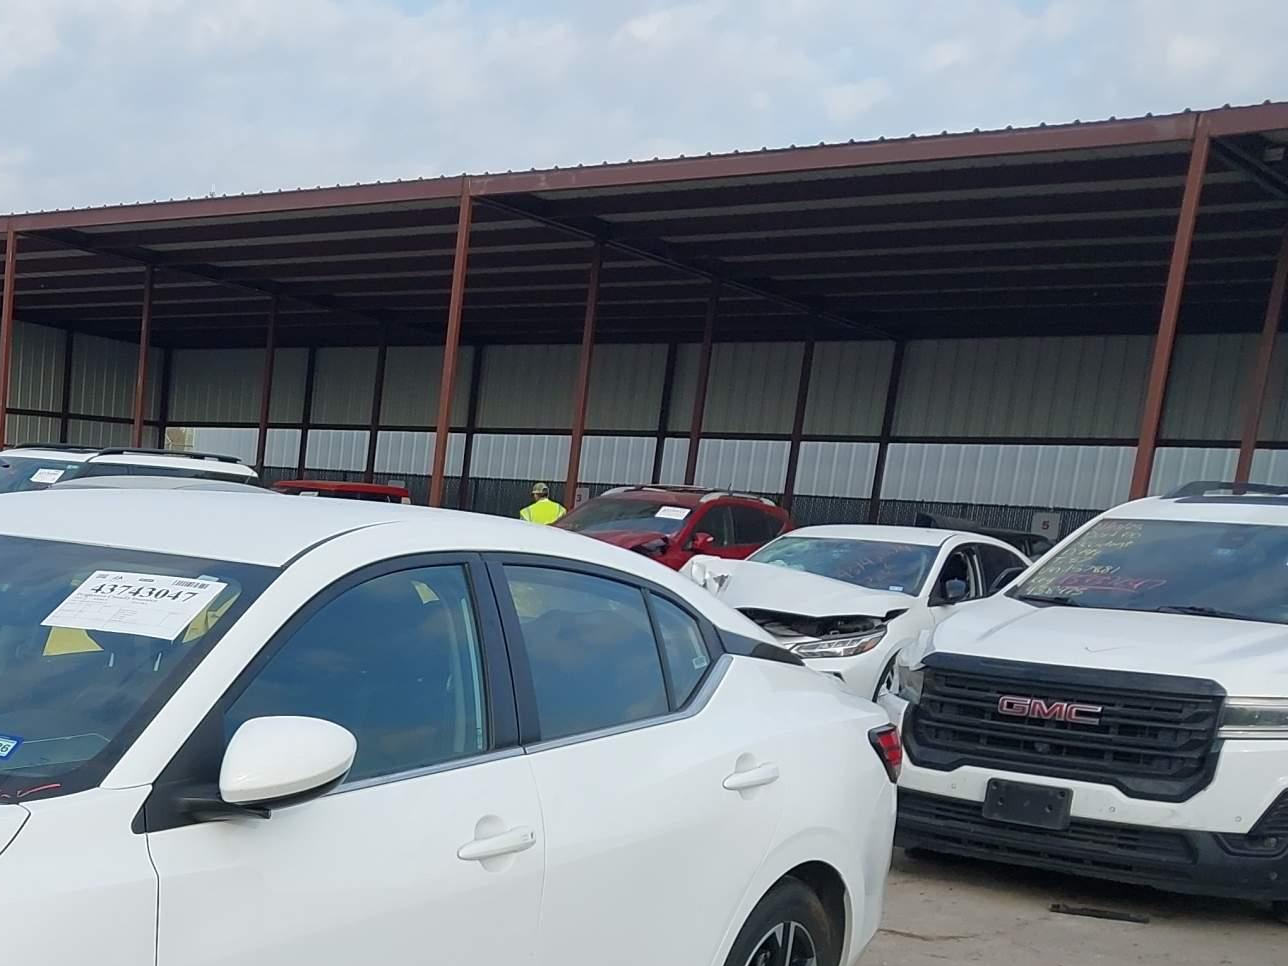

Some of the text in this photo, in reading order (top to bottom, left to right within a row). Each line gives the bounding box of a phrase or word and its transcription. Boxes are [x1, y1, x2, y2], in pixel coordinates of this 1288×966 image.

[1042, 520, 1050, 530] 5
[91, 583, 199, 602] 43743047
[998, 696, 1102, 725] GMC
